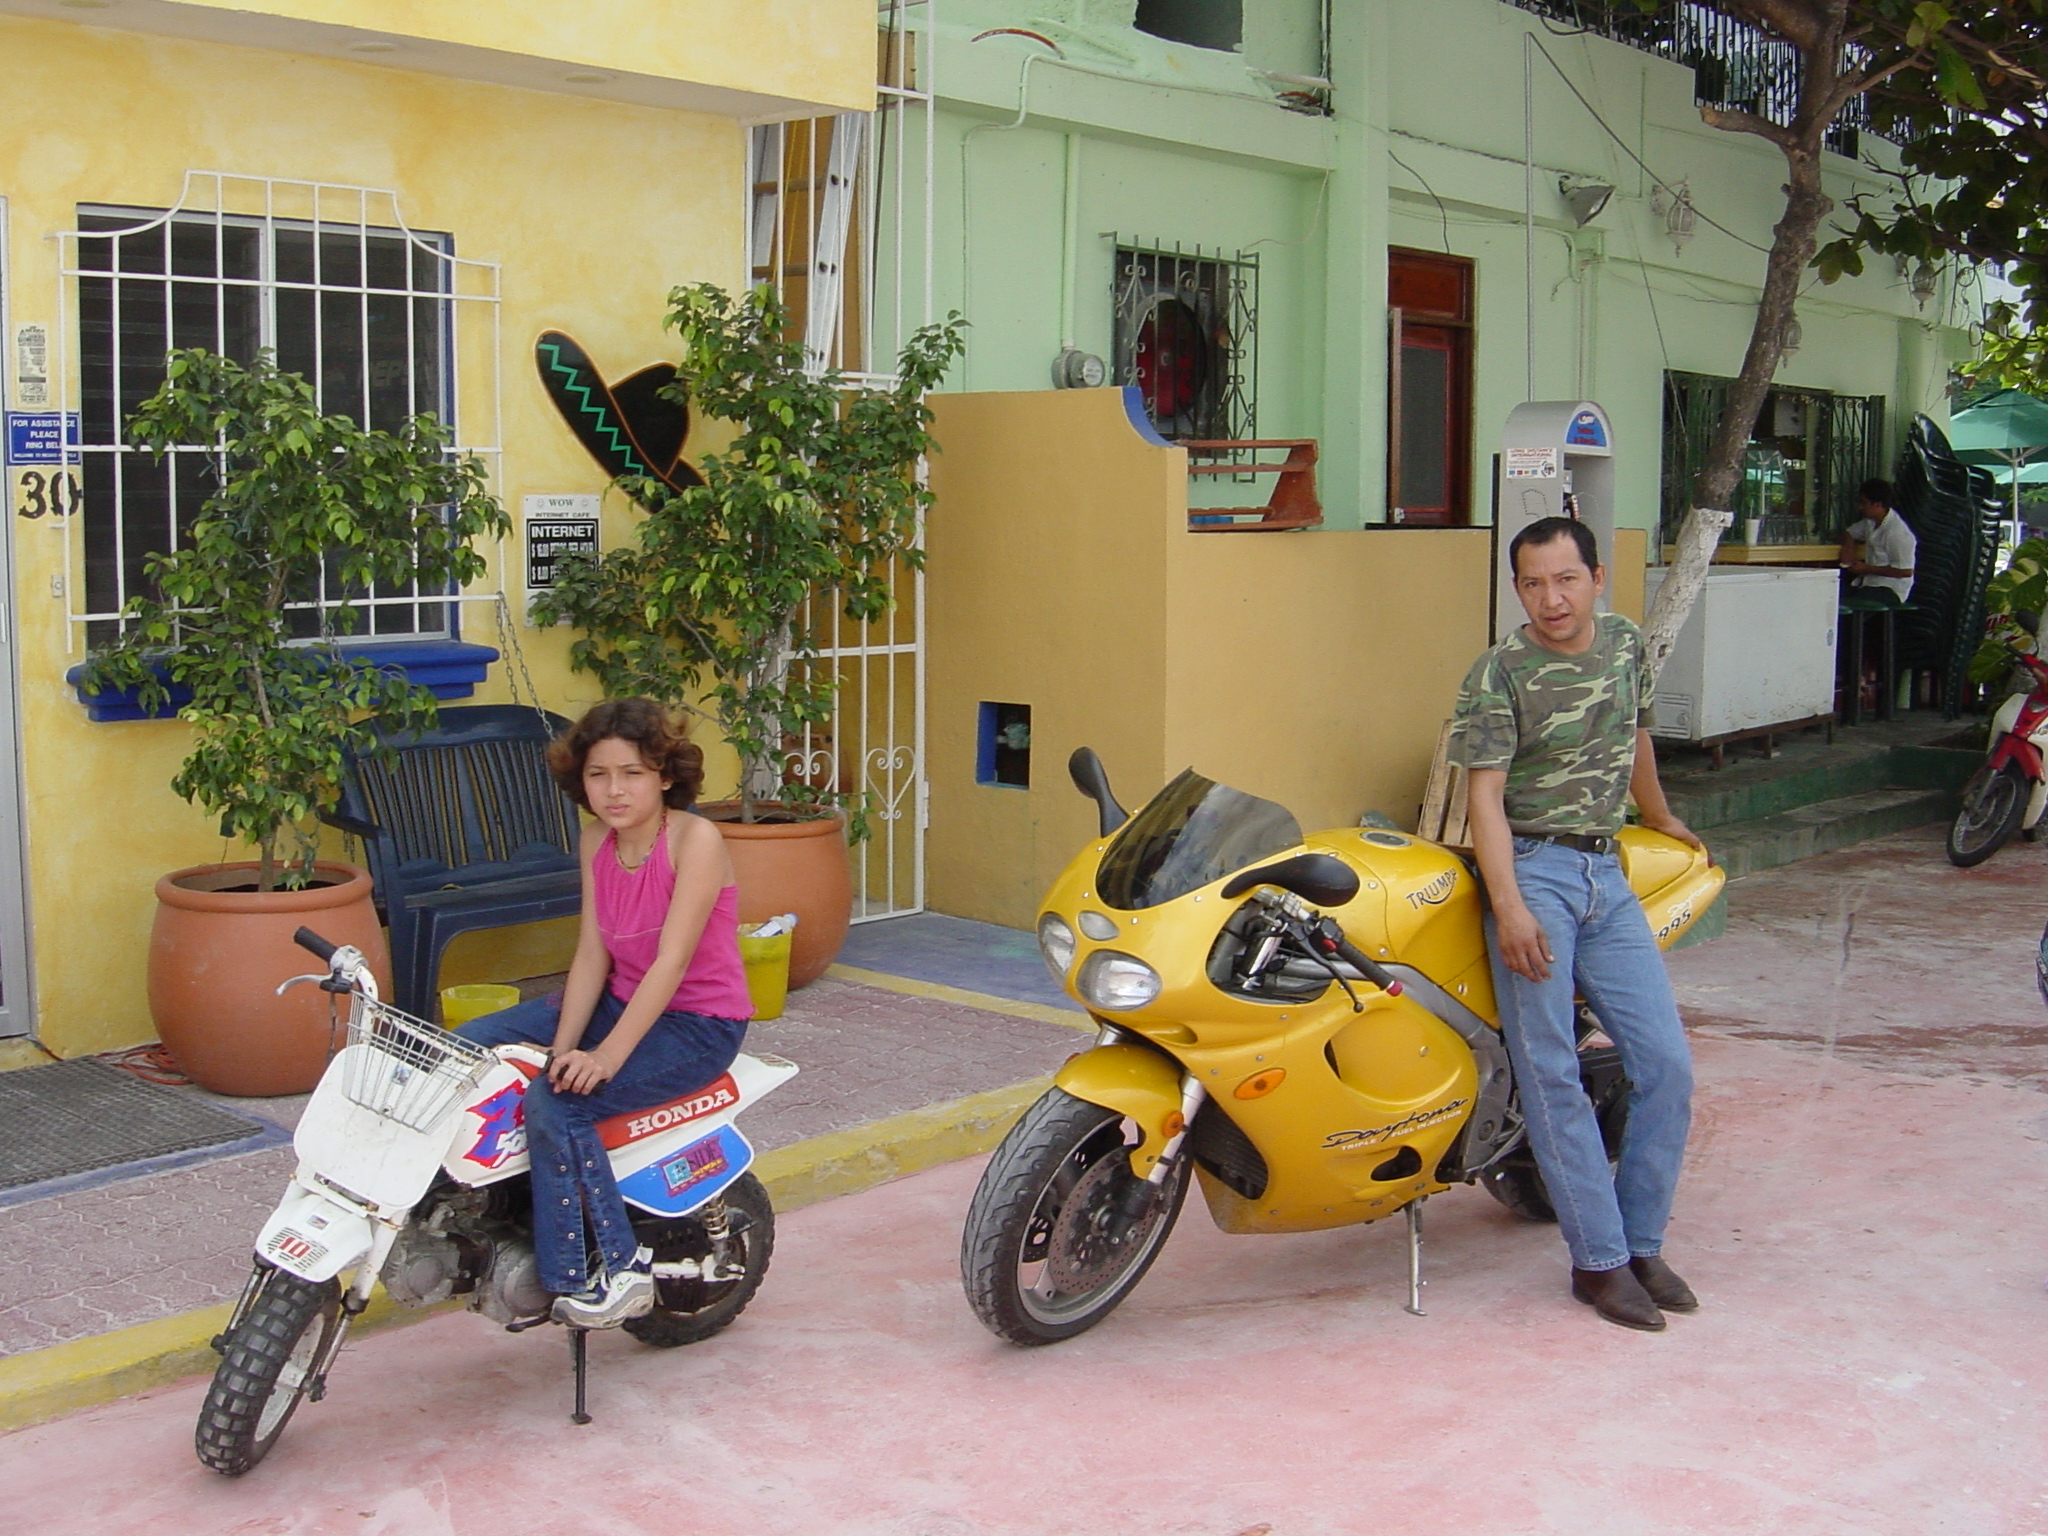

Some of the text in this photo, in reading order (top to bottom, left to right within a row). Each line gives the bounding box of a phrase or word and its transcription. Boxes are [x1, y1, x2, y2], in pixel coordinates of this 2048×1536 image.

[18, 471, 83, 519] 30
[531, 525, 594, 538] INTERNET
[1405, 866, 1457, 910] TRIUMPH
[627, 1088, 734, 1139] HONDA
[1321, 1098, 1469, 1148] Daytona
[1341, 1109, 1463, 1151] TRIPLE FUEL INJECTION
[278, 1236, 312, 1259] 10
